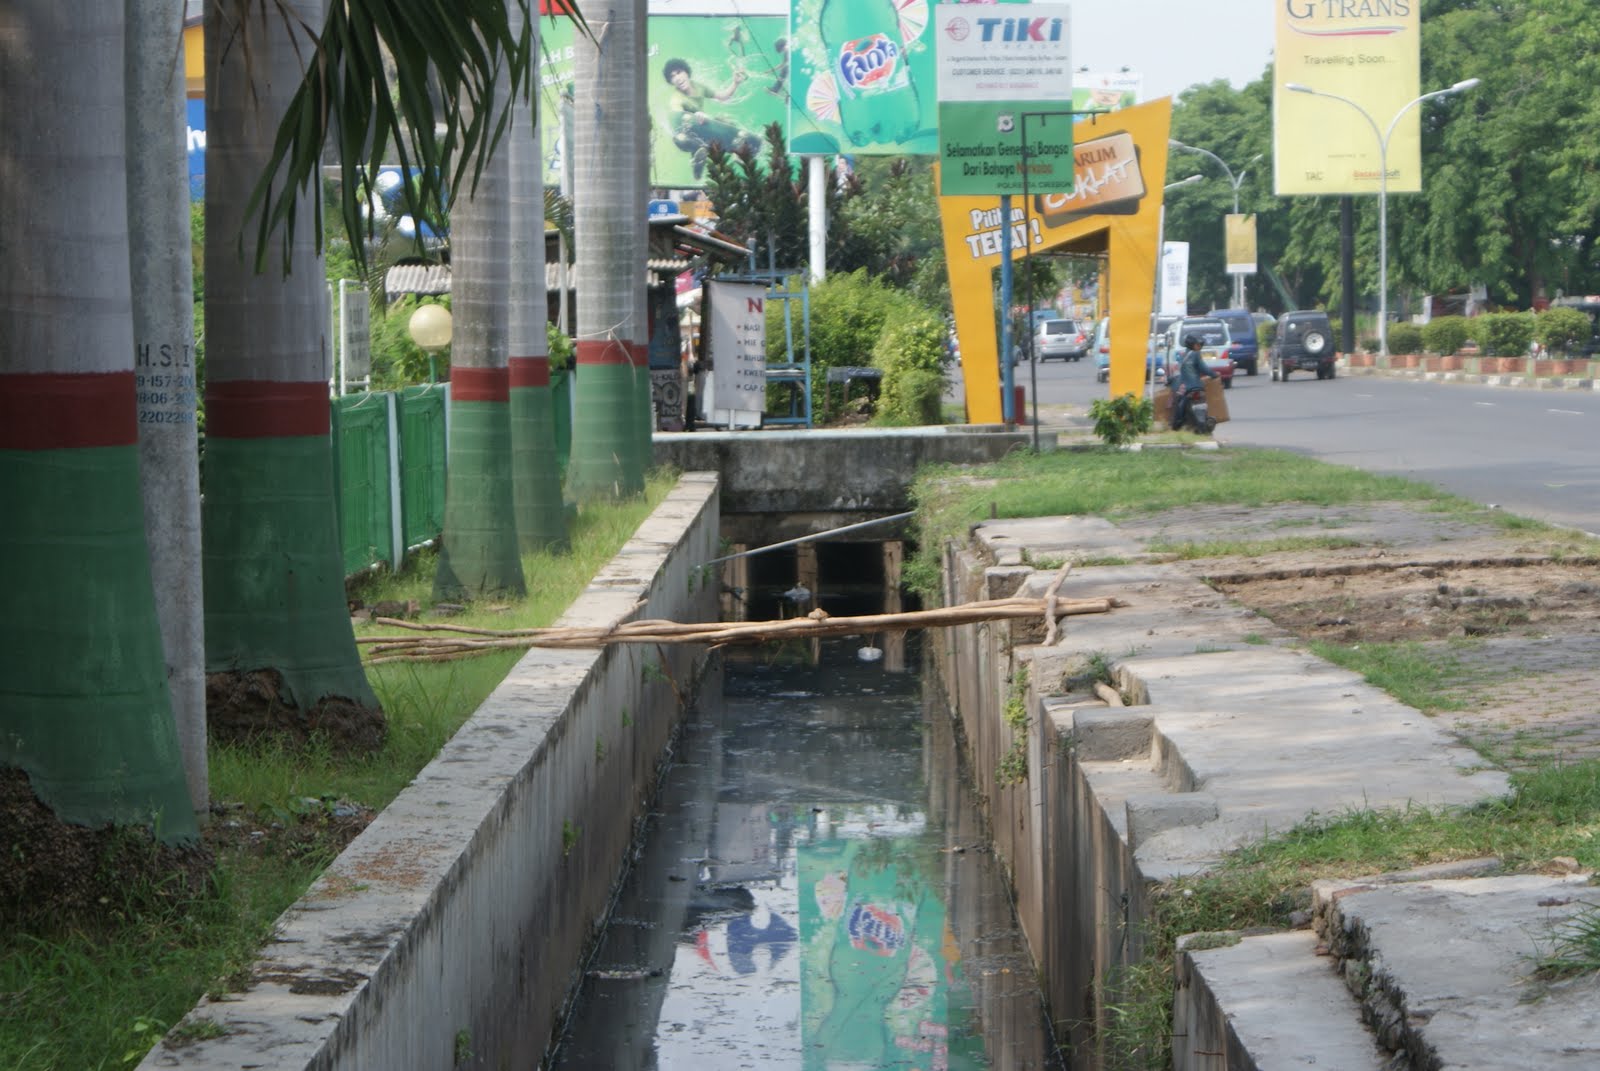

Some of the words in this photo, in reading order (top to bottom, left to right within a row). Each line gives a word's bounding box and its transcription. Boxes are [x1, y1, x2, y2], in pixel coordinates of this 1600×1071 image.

[840, 39, 898, 87] Fanta
[1303, 55, 1354, 66] Travelling
[946, 142, 995, 158] Selamatkan
[1038, 141, 1069, 158] Bangsa
[963, 162, 981, 176] Dari
[983, 161, 1015, 179] Bahaya
